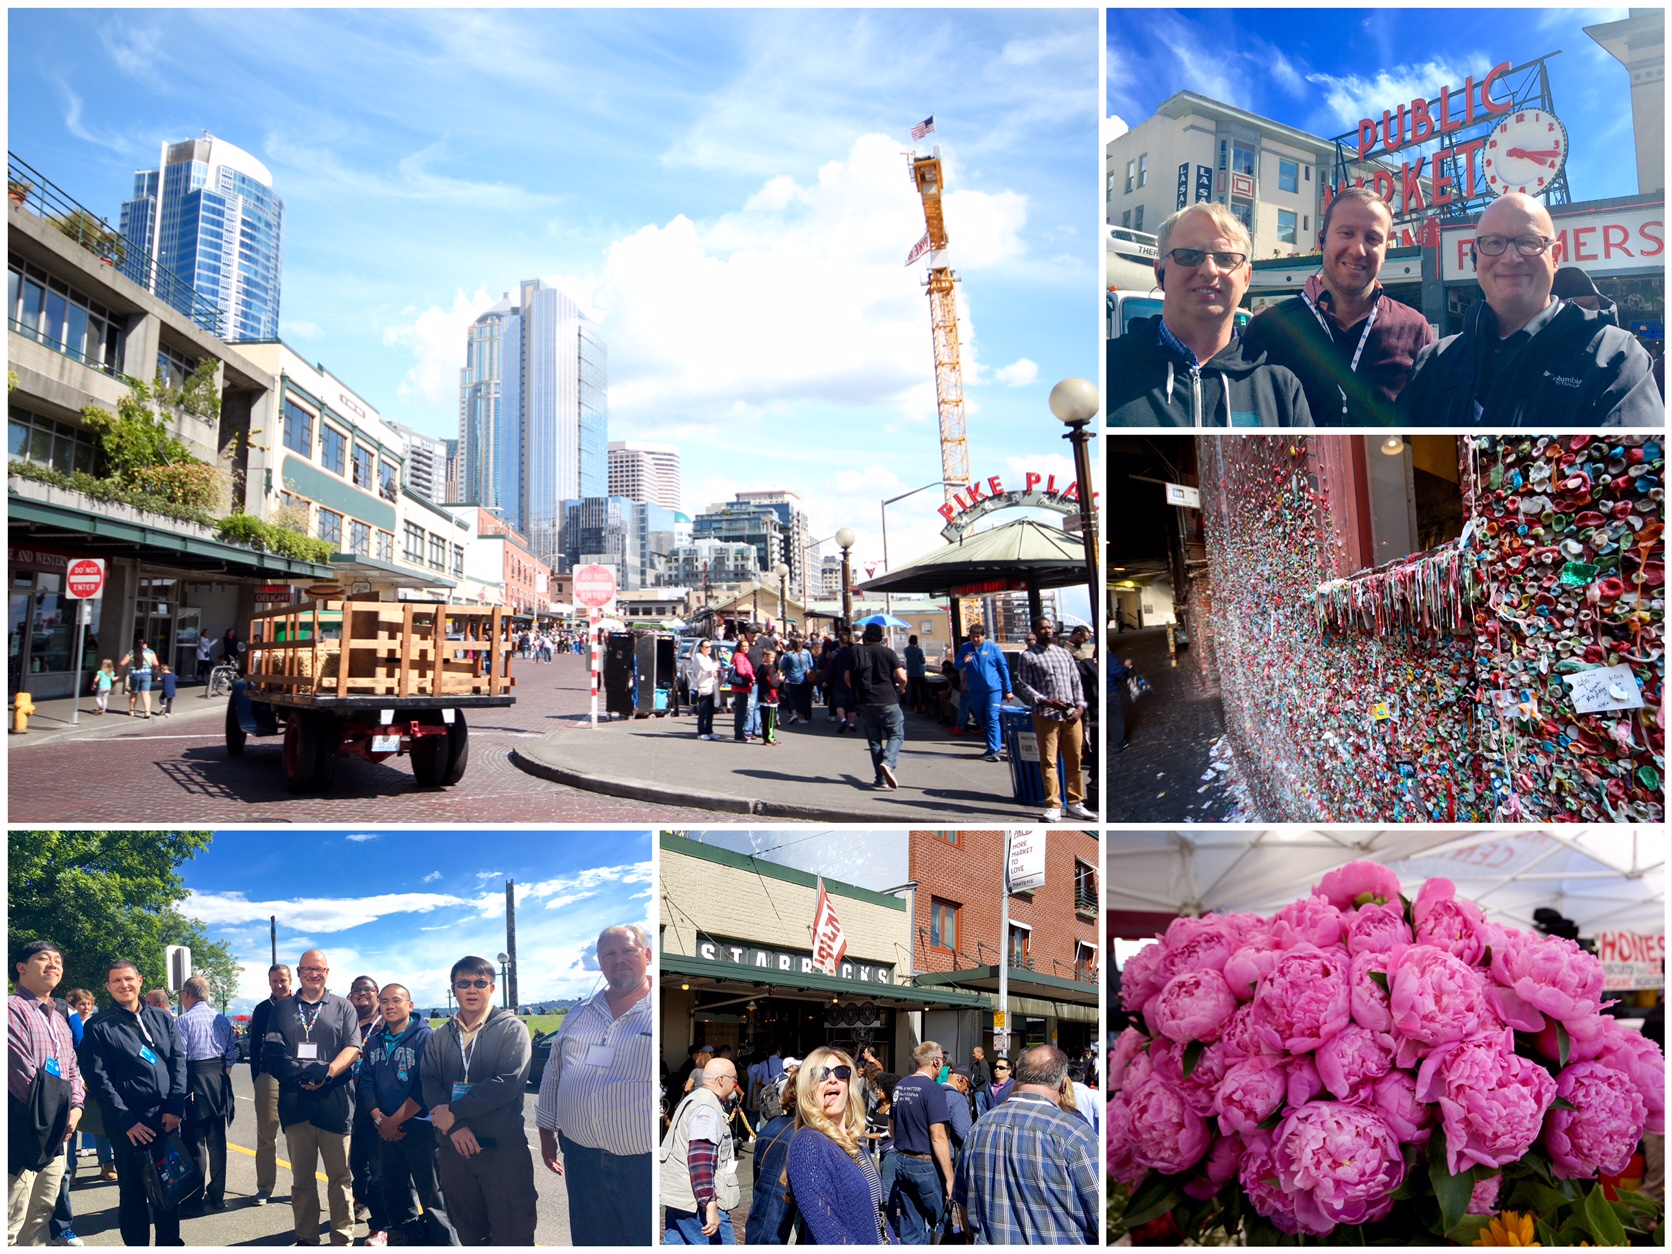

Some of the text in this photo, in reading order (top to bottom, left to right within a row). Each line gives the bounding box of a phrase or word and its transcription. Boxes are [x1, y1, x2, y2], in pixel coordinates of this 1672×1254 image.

[1358, 61, 1513, 163] PUBLIC
[1515, 113, 1525, 124] 12
[1535, 113, 1540, 122] 1
[1500, 123, 1507, 133] 11
[1547, 122, 1555, 132] 2
[1489, 139, 1497, 149] 10
[1553, 140, 1560, 150] 3
[1485, 159, 1492, 168] 9
[1548, 160, 1556, 170] 4
[1489, 175, 1497, 185] 8
[1537, 176, 1545, 187] 5
[1502, 185, 1509, 194] 7
[937, 476, 1005, 523] PIKE
[17, 549, 34, 563] AND
[255, 593, 289, 601] DELIGHT
[581, 592, 607, 600] ENTER
[1012, 840, 1028, 850] MORE
[1011, 846, 1033, 858] MARKET
[1010, 865, 1024, 875] LOVE
[1602, 931, 1665, 962] HONES
[700, 942, 887, 983] STARBCKS
